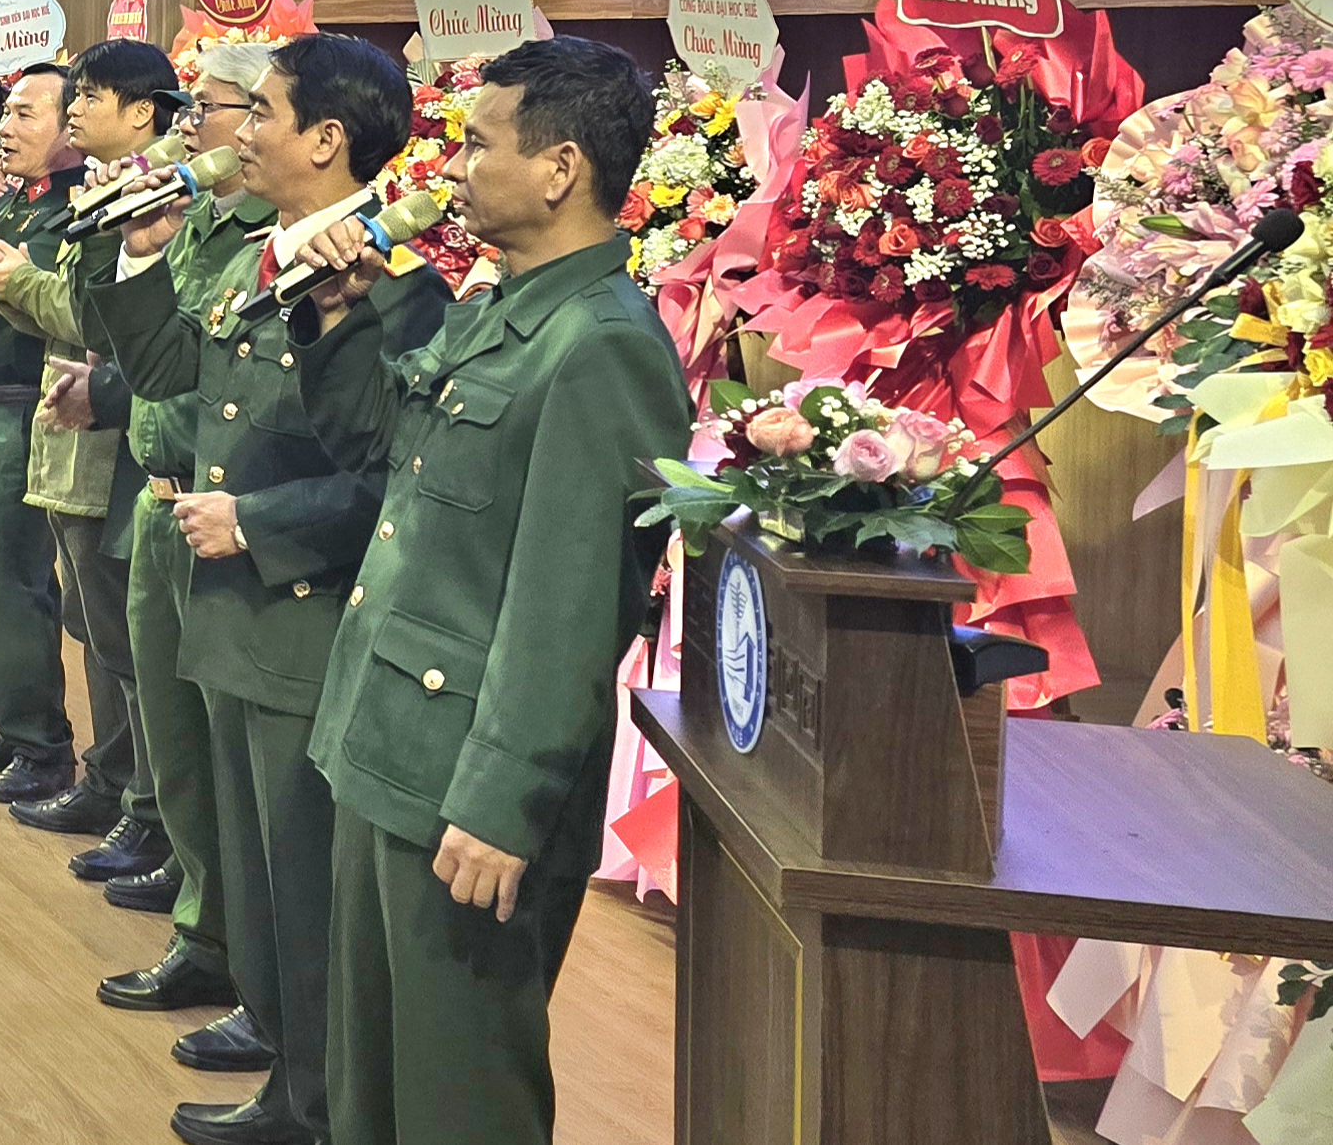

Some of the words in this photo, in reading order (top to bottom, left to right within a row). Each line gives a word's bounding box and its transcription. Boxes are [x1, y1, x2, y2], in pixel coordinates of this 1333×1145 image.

[429, 8, 471, 37] Chúc
[473, 4, 525, 37] Mừng
[717, 0, 728, 18] ĐẠI
[729, 2, 742, 19] HỌC
[1, 29, 49, 52] Mừng
[684, 25, 715, 54] Chúc
[720, 29, 761, 68] Mừng
